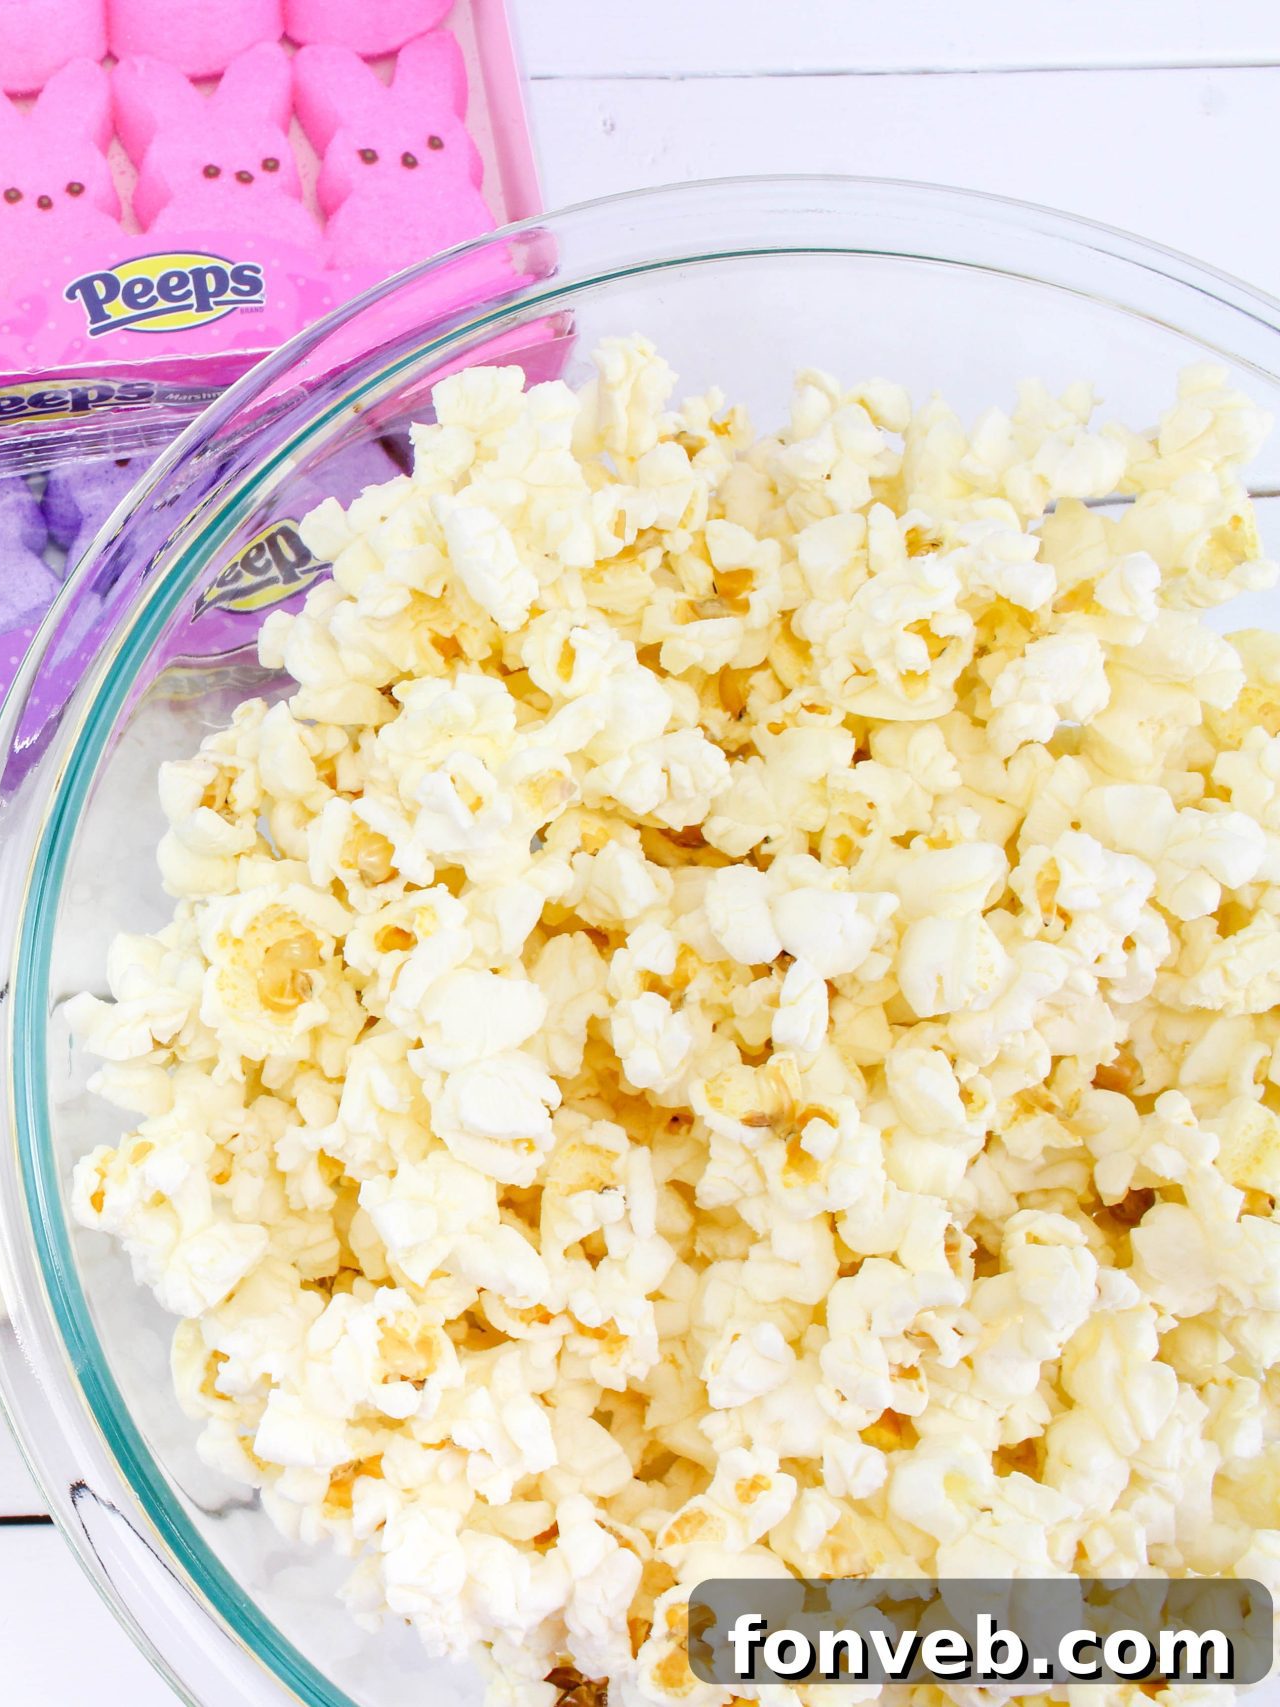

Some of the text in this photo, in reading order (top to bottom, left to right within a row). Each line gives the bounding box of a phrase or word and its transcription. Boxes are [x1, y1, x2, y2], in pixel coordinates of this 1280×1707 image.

[65, 264, 263, 326] Peeps
[239, 306, 265, 315] BRAND
[194, 526, 313, 614] eep
